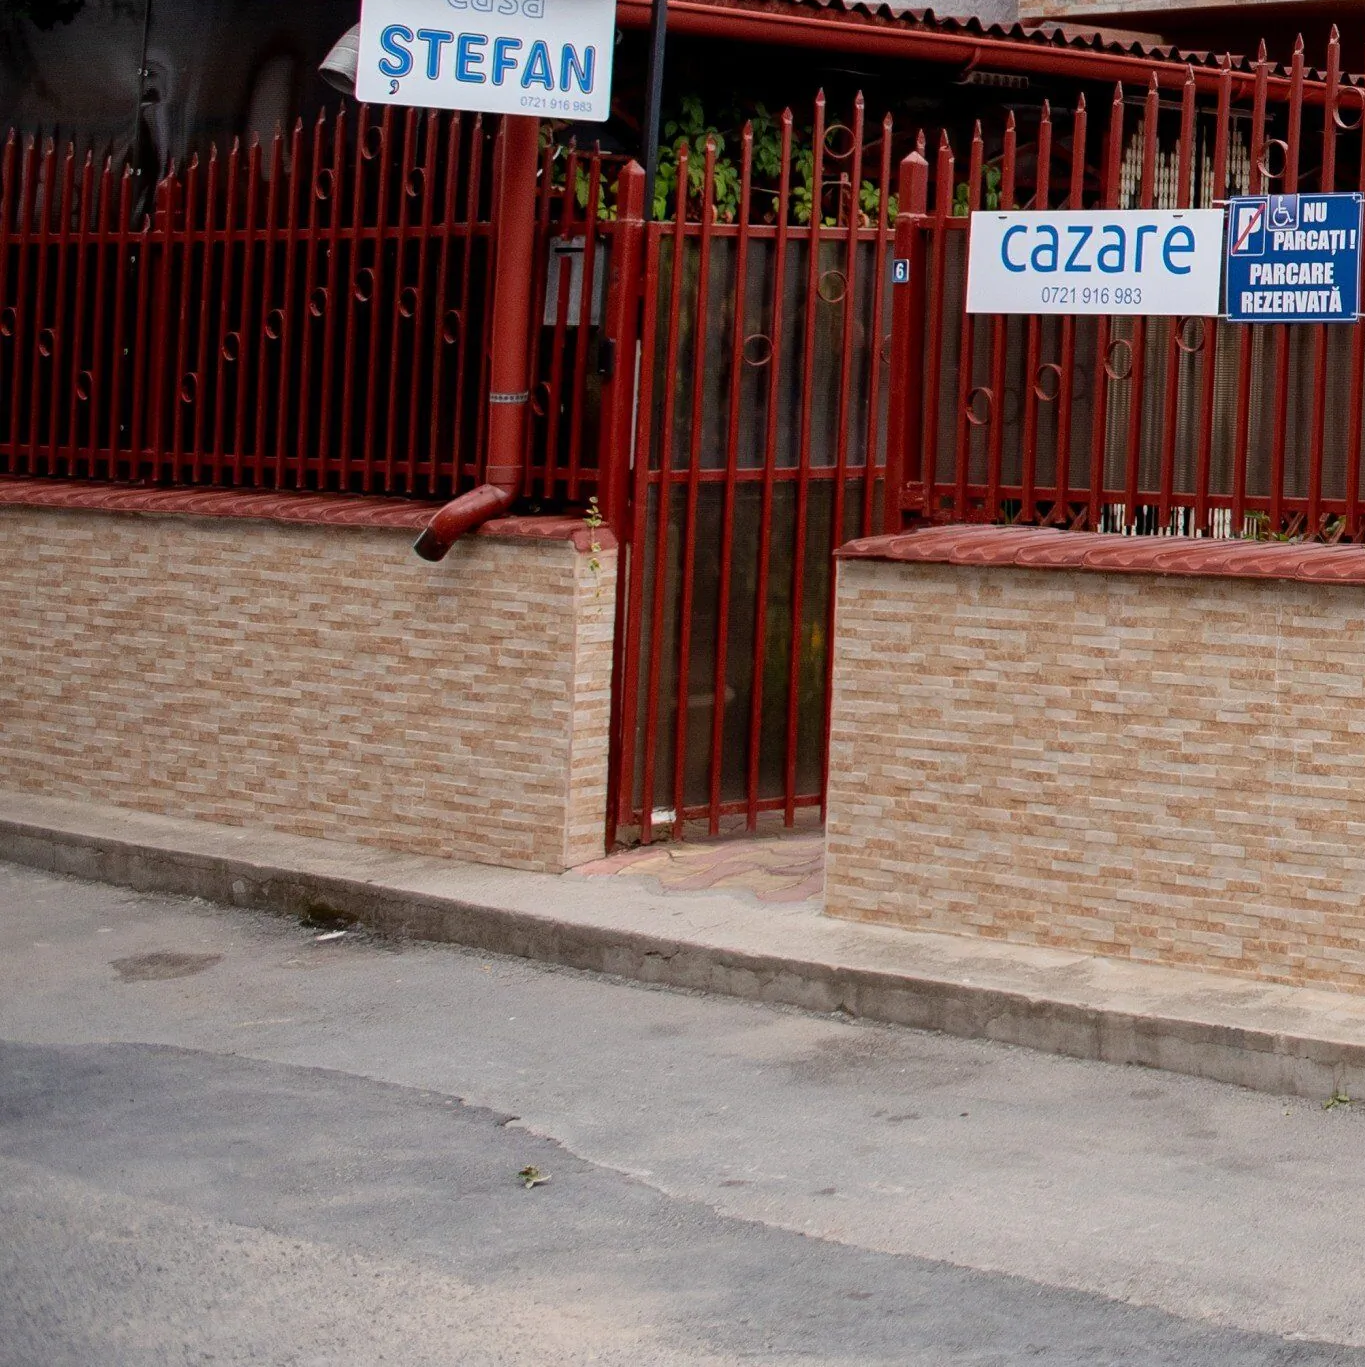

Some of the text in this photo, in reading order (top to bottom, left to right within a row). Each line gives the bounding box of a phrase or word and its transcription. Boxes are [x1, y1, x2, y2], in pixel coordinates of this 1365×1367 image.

[378, 24, 597, 95] ȘTEFAN
[520, 96, 593, 112] 0721 916 983
[1303, 202, 1328, 223] NU
[1001, 224, 1196, 275] cazare
[896, 262, 905, 280] 6
[1249, 262, 1335, 286] PARCARE
[1041, 286, 1142, 305] 0721 916 983
[1241, 285, 1343, 314] REZERVATĂ
